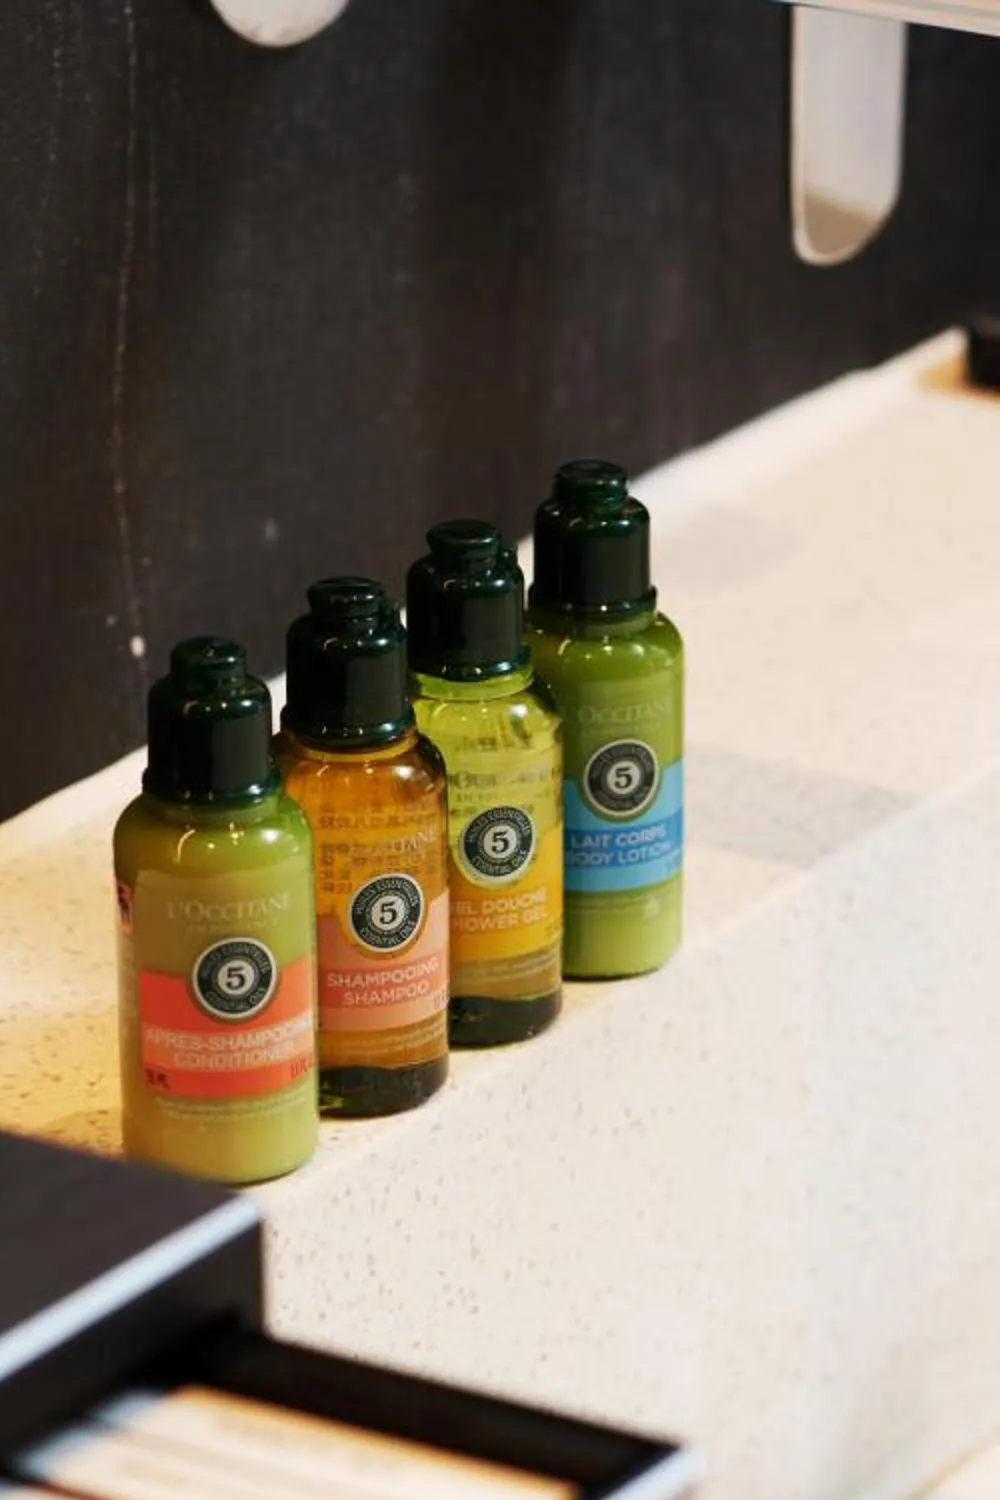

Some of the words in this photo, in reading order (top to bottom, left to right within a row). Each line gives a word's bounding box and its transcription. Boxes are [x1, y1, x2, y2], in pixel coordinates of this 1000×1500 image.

[614, 767, 632, 789] 5
[492, 829, 509, 853] 5
[570, 833, 612, 849] LAIT
[379, 901, 397, 925] 5
[451, 901, 479, 915] EL
[453, 912, 519, 932] HOWER
[523, 905, 548, 925] GEL
[226, 966, 246, 991] 5
[327, 956, 439, 990] SHAMPOOING
[343, 980, 430, 1006] SHAMPOO
